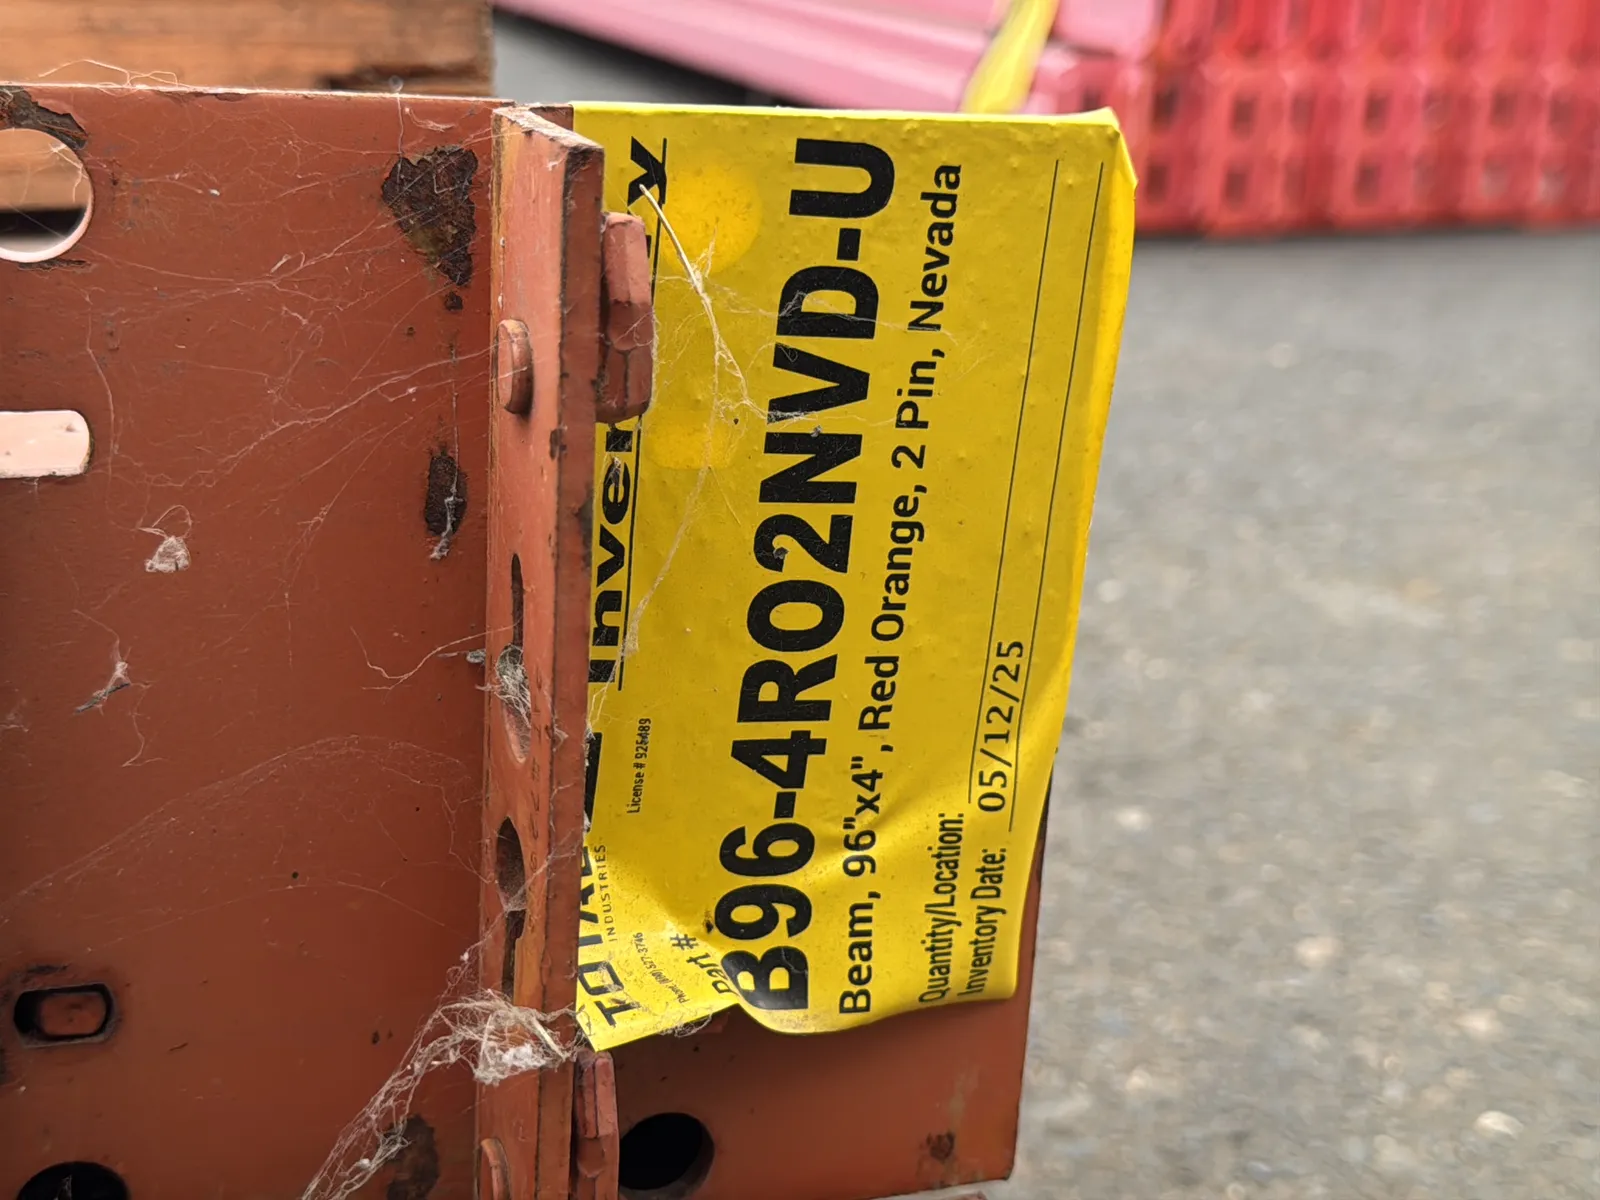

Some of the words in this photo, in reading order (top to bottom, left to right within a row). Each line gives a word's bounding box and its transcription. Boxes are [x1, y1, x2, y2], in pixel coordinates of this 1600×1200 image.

[906, 164, 962, 333] Nevada
[895, 348, 946, 430] Pin,
[891, 444, 926, 470] 2
[714, 137, 895, 1010] B96-4RO2NVD-U
[870, 484, 928, 642] Orange,
[857, 655, 900, 731] Red
[977, 640, 1025, 813] 05/12/25
[627, 771, 645, 814] License
[633, 762, 646, 770] #
[594, 845, 618, 942] INDUSTRIES
[918, 812, 964, 1004] Quantity/Location:
[970, 847, 1007, 901] Date:
[669, 932, 700, 951] #
[685, 952, 739, 995] Part
[838, 891, 881, 1014] Beam,
[956, 904, 1007, 997] Inventory
